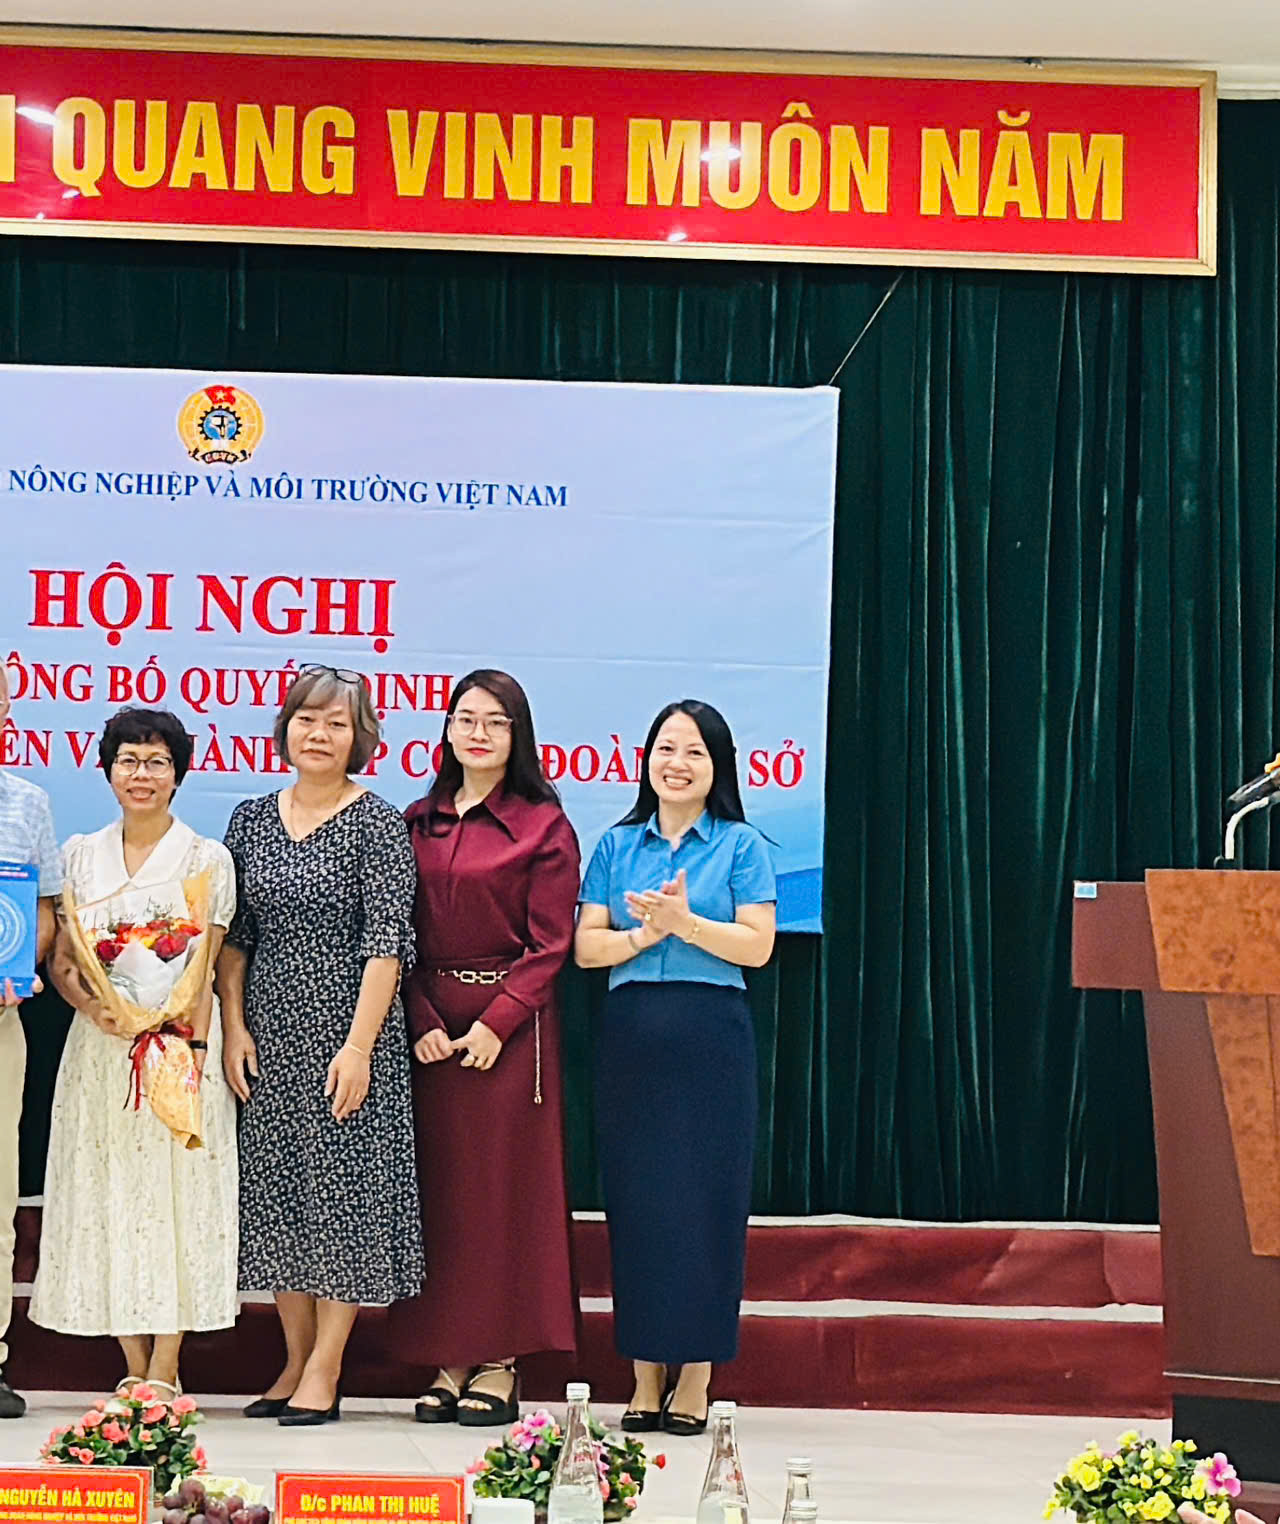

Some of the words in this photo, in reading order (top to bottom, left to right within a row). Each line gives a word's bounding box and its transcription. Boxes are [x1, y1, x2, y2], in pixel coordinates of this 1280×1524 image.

[52, 97, 355, 198] QUANG
[386, 109, 593, 204] VINH
[627, 102, 889, 213] MUÔN
[920, 110, 1123, 221] NĂM
[10, 464, 87, 493] NÔNG
[95, 471, 199, 501] NGHIỆP
[206, 470, 240, 498] VÀ
[250, 472, 303, 499] MÔI
[312, 475, 428, 503] TRƯỜNG
[436, 480, 499, 510] VIỆT
[506, 485, 568, 507] NAM
[29, 562, 173, 645] HỘI
[196, 574, 396, 653] NGHỊ
[6, 651, 94, 702] ÔNG
[107, 655, 167, 704] BỐ
[180, 659, 299, 713] QUYẾ
[361, 673, 454, 720] ỊNH
[64, 731, 104, 768] V
[748, 739, 805, 788] SỞ
[86, 1488, 135, 1508] XUYÊN
[331, 1494, 375, 1513] PHAN
[379, 1495, 404, 1517] THỊ
[409, 1494, 441, 1517] HUỆ
